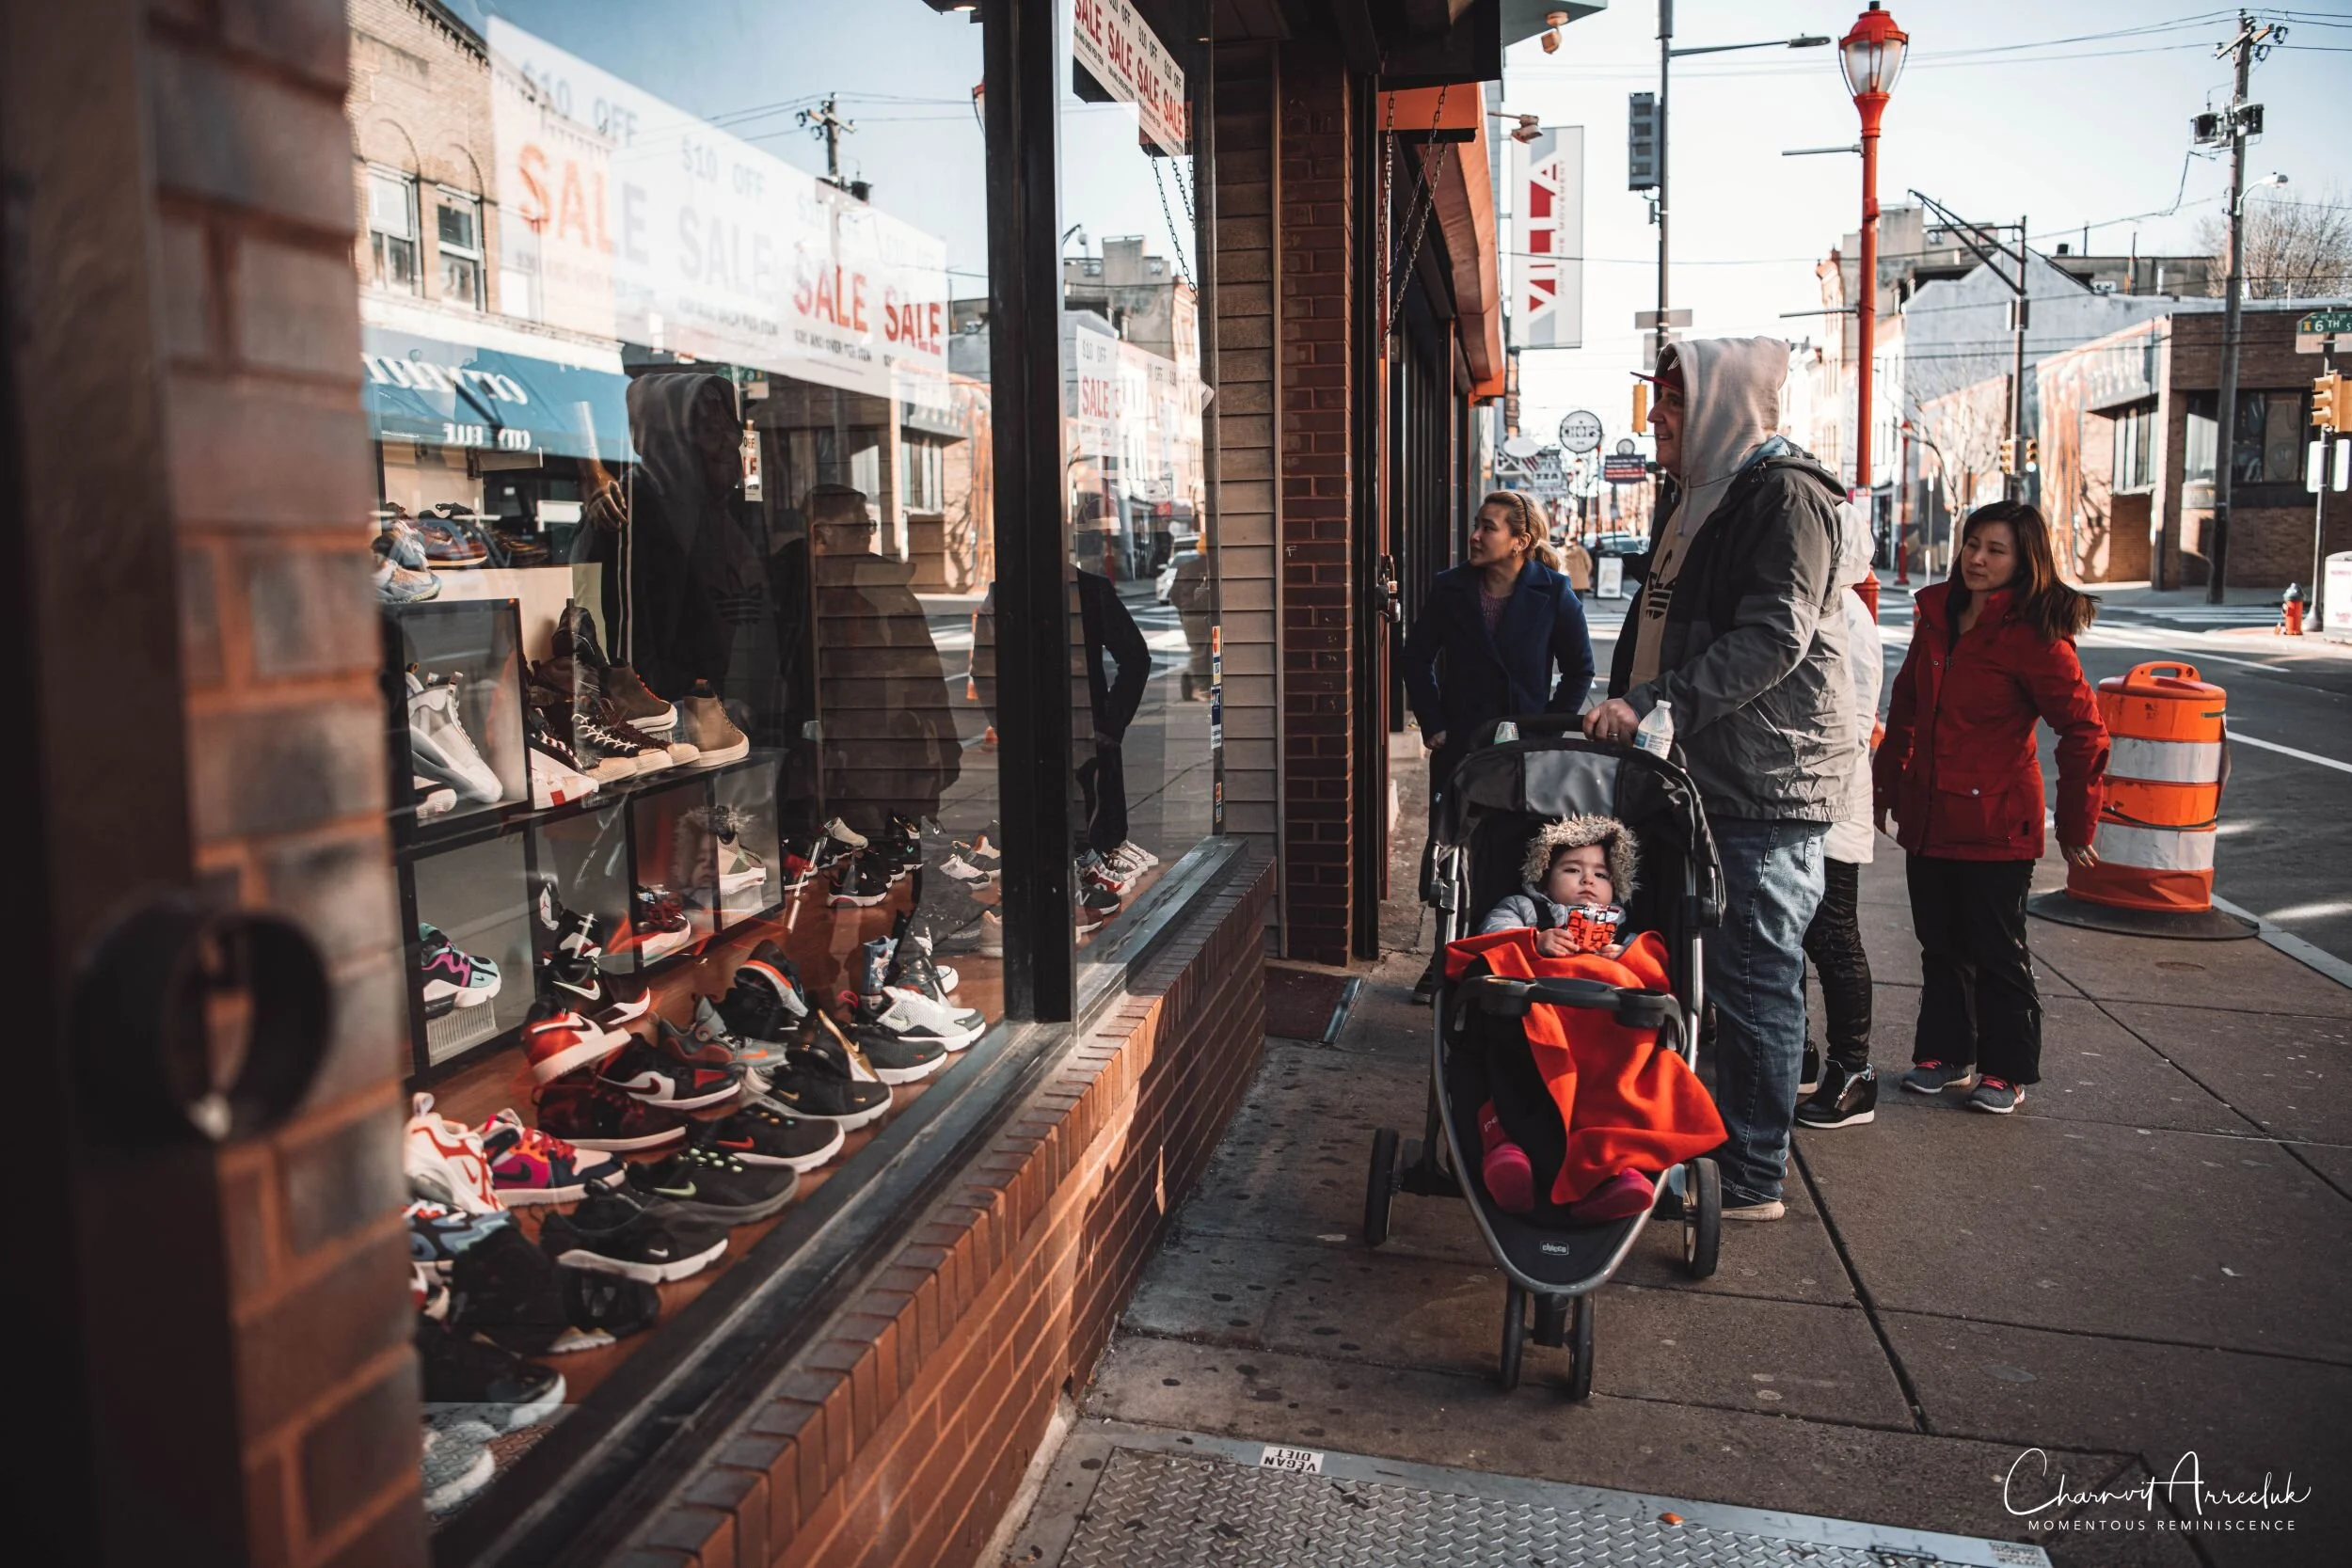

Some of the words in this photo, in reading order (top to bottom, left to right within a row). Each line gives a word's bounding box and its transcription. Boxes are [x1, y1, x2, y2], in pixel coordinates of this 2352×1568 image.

[1075, 0, 1102, 47] SALE
[1108, 21, 1132, 82] SALE
[1137, 56, 1160, 112] SALE
[1164, 88, 1183, 139] SALE
[680, 133, 719, 183] $10
[732, 162, 767, 204] OFF
[516, 141, 649, 266] SALE
[677, 205, 778, 306] SALE
[1530, 152, 1557, 323] VILLA
[793, 241, 869, 333] SALE
[883, 284, 943, 356] SALE
[1082, 375, 1110, 419] SALE
[1263, 1456, 1316, 1472] VEGAN
[1275, 1449, 1311, 1462] DIET
